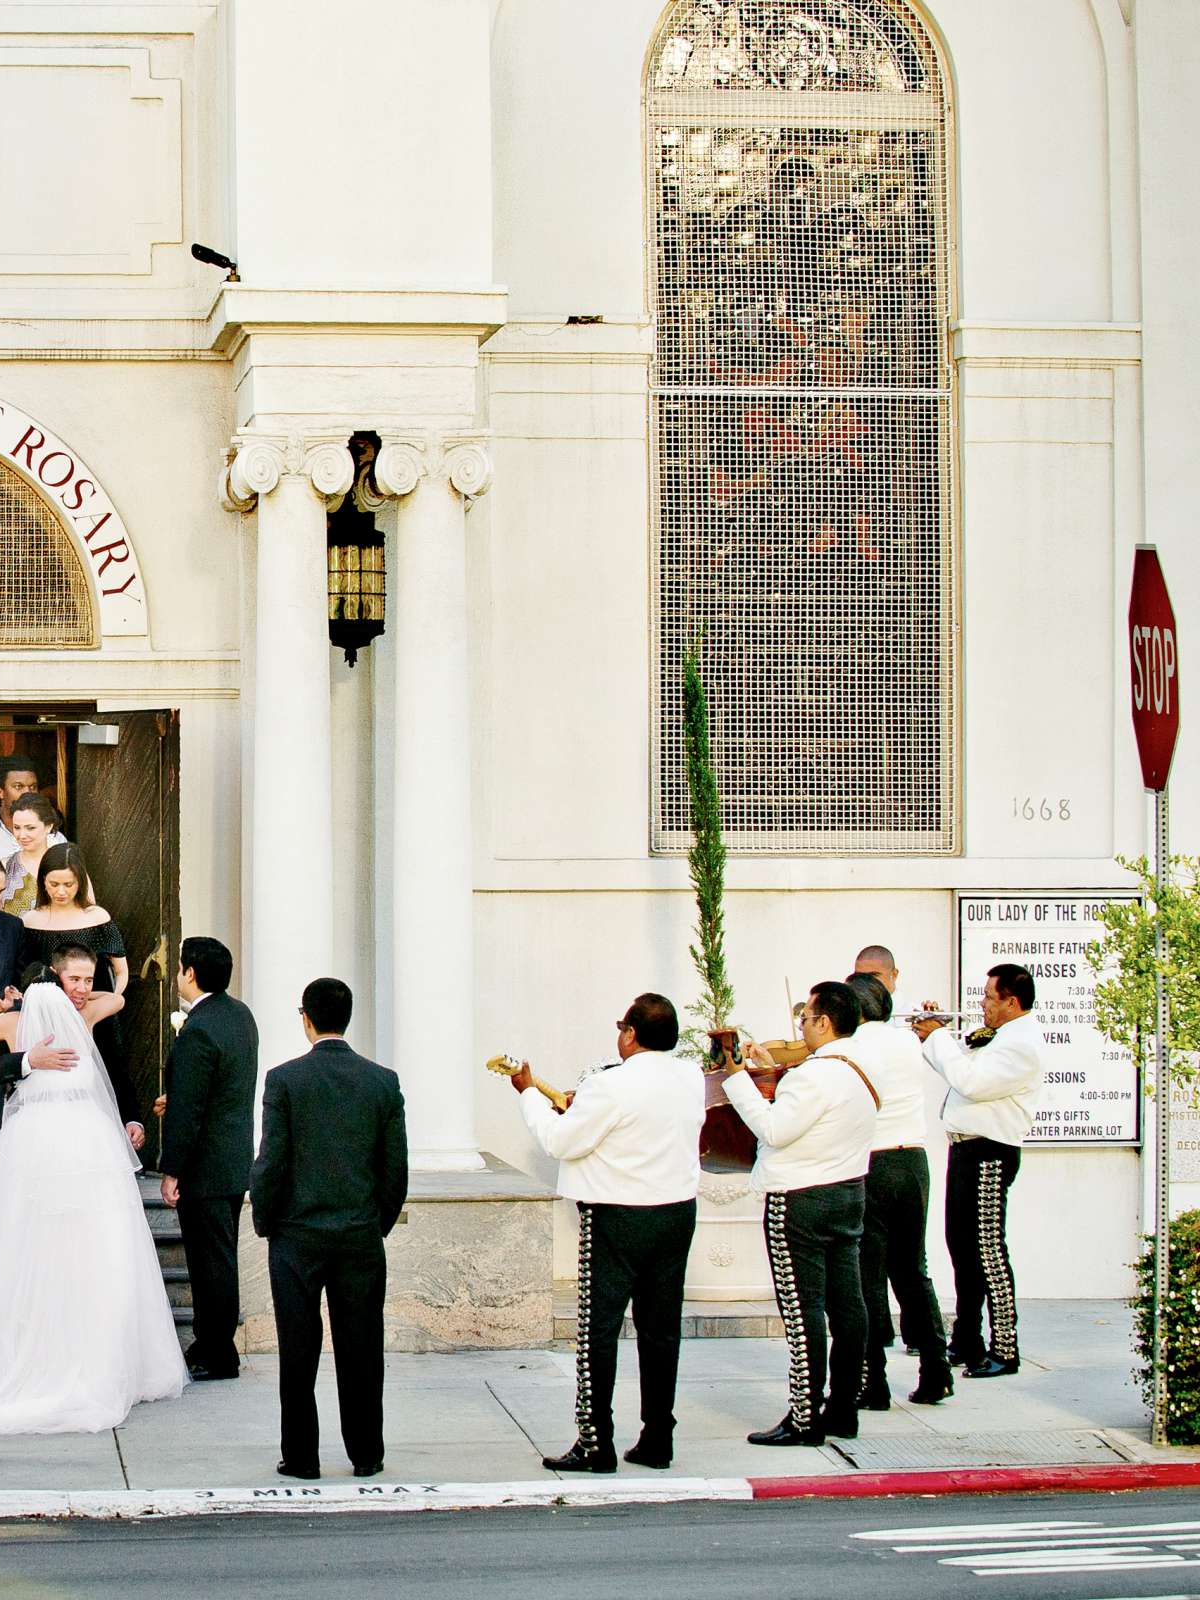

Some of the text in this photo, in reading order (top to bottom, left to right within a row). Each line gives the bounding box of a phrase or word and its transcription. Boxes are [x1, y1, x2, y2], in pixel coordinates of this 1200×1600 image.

[10, 424, 142, 606] ROSARY
[1132, 624, 1175, 715] STOP
[1011, 796, 1071, 821] 1668
[967, 904, 992, 921] OUR
[999, 904, 1028, 921] LADY
[1034, 904, 1049, 921] OF
[1055, 904, 1077, 921] THE
[992, 942, 1108, 954] BARNABITE FATHES
[966, 986, 985, 996] DAIL
[1043, 1032, 1071, 1043] VENA
[1035, 1111, 1090, 1121] ADY'S GIFTS
[1063, 1126, 1103, 1136] PARKING
[1106, 1126, 1123, 1136] LOT
[252, 1487, 321, 1497] MIN
[358, 1485, 440, 1495] MAX
